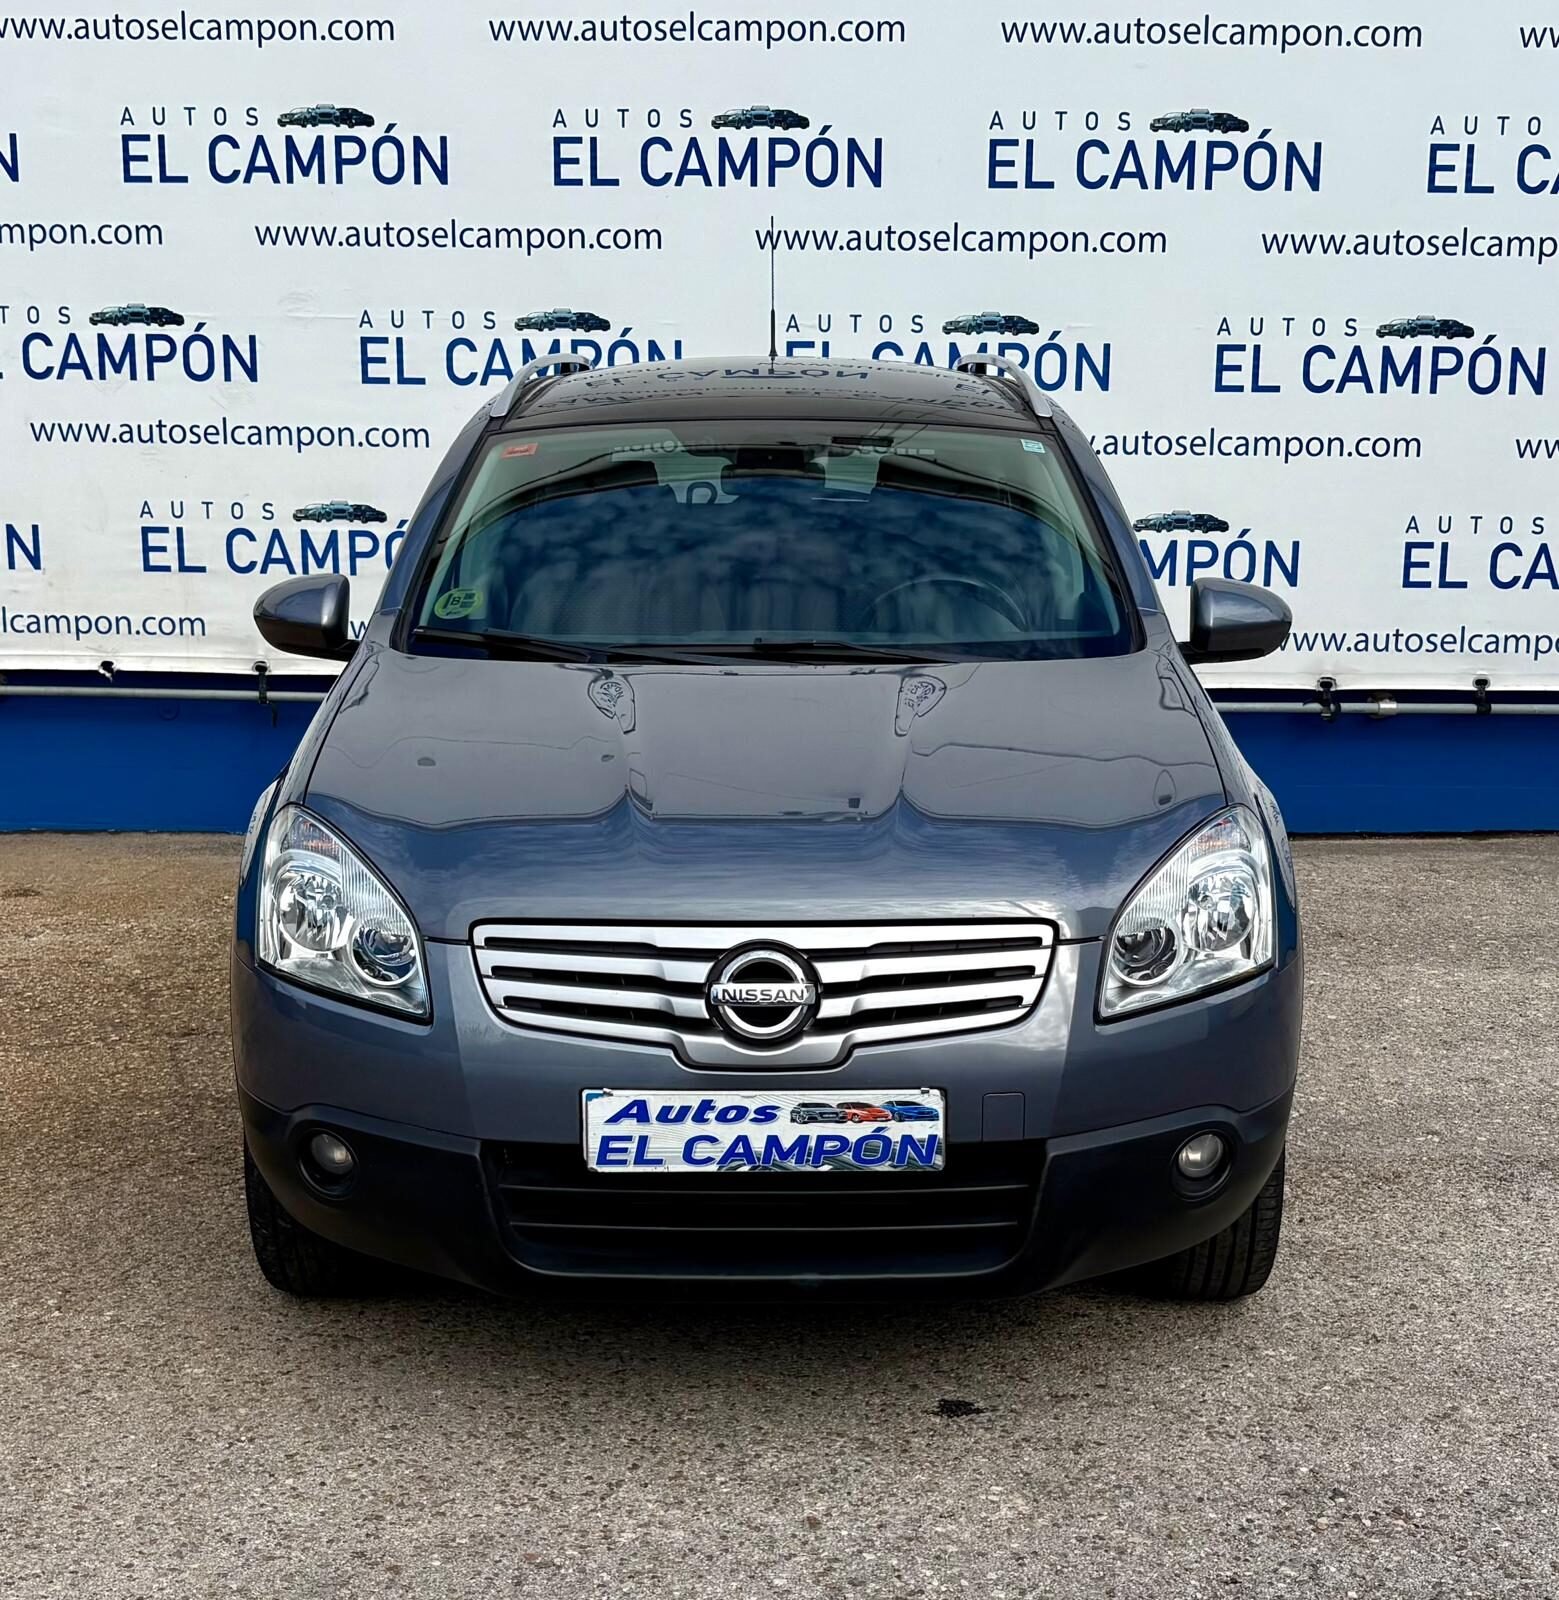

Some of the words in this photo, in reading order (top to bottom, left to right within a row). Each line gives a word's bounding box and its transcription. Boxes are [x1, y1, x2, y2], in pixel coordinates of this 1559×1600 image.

[489, 11, 904, 49] www.autoselcampon.com
[1001, 15, 1421, 53] www.autoselcampon.com
[121, 106, 258, 127] AUTOS
[553, 108, 692, 129] AUTOS
[989, 110, 1130, 131] AUTOS
[1431, 115, 1541, 136] AUTO
[121, 134, 188, 183] EL
[209, 123, 448, 185] CAMPÓN
[553, 137, 619, 186] EL
[641, 125, 882, 187] CAMPÓN
[988, 139, 1054, 189] EL
[1077, 128, 1321, 191] CAMPÓN
[1427, 144, 1494, 193] EL
[1517, 144, 1559, 194] C
[0, 222, 163, 251] mpon.com
[255, 219, 661, 256] www.autoselcampon.com
[755, 222, 1166, 259] www.autoselcampon.com
[1262, 227, 1558, 264] www.autoselcamp
[0, 306, 70, 324] TOS
[360, 310, 495, 329] AUTOS
[786, 314, 923, 333] AUTOS
[1217, 317, 1357, 337] AUTOS
[22, 322, 258, 382] CAMPÓN
[360, 337, 426, 385] EL
[1215, 344, 1280, 393] EL
[1303, 335, 1546, 396] CAMPÓN
[30, 417, 429, 453] www.autoselcampon.com
[1090, 428, 1421, 464] .autoselcampon.com
[140, 500, 274, 520] AUTOS
[1405, 516, 1544, 535] AUTOS
[6, 524, 41, 570] N
[141, 526, 207, 573] EL
[1402, 542, 1467, 588] EL
[1490, 543, 1559, 590] CA
[2, 606, 206, 641] lcampon.com
[1280, 626, 1559, 661] ww.autoselcamp
[722, 988, 804, 1002] NISSAN
[603, 1099, 779, 1125] Autos
[596, 1135, 664, 1167] EL
[682, 1127, 939, 1168] CAMPÓN
